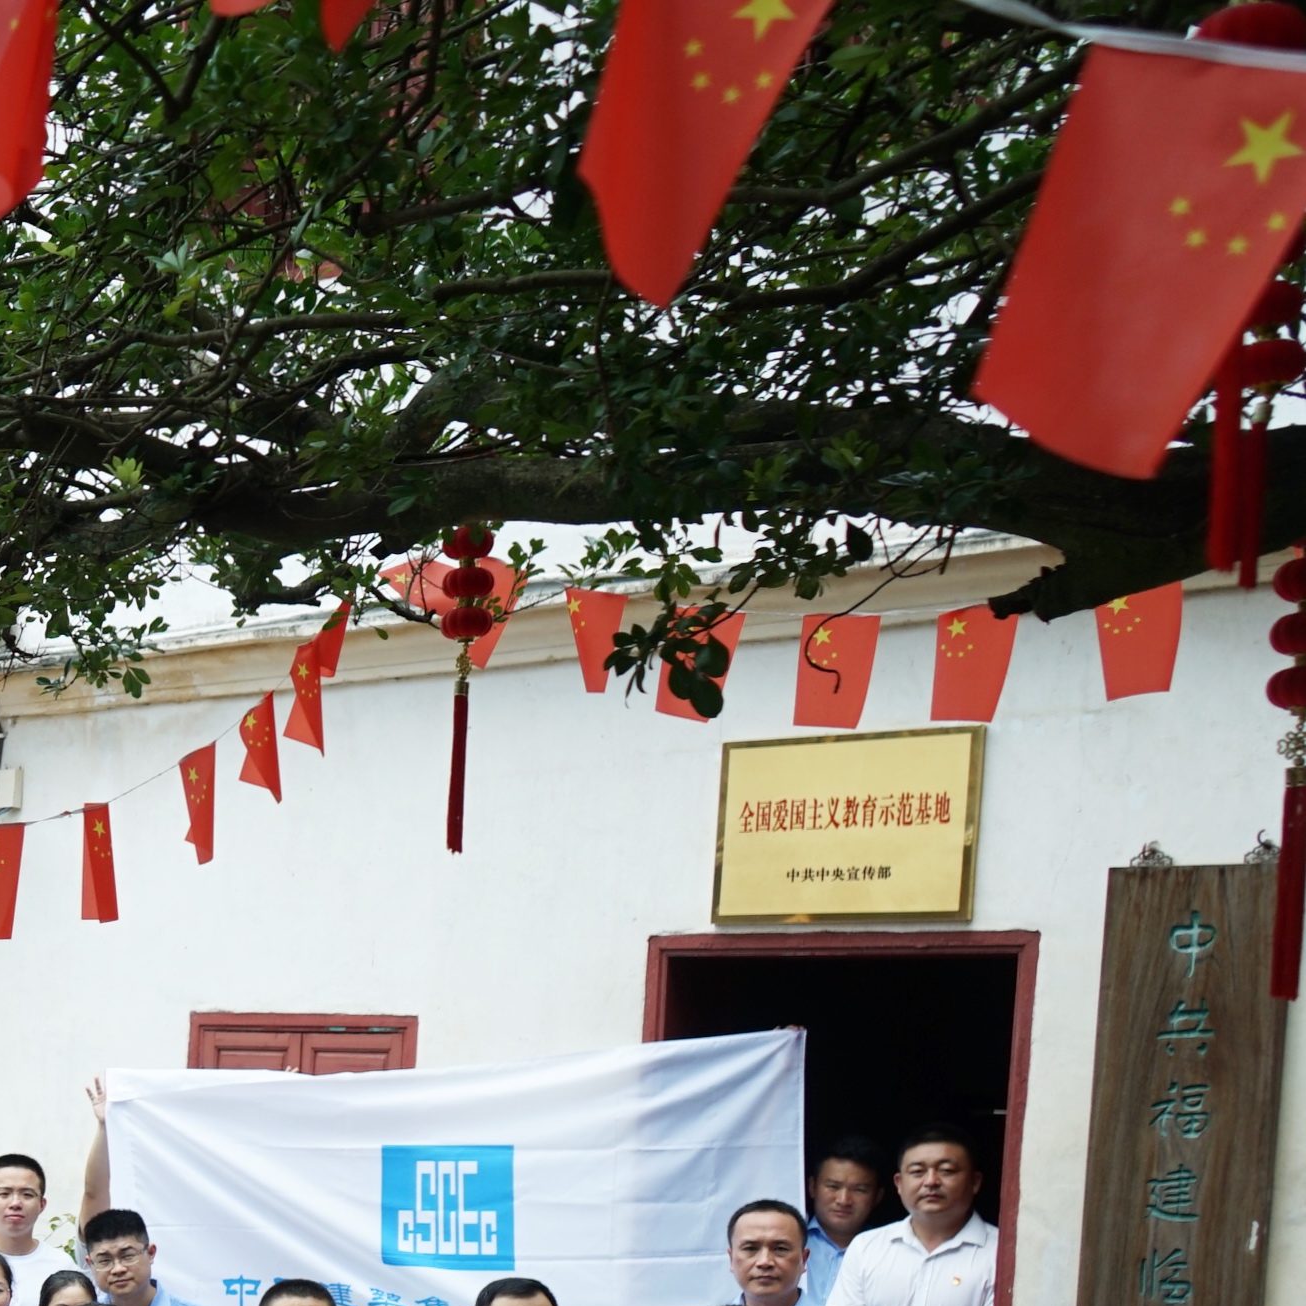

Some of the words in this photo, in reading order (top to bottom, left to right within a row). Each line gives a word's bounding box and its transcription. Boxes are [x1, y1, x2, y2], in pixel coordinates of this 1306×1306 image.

[739, 791, 951, 834] 全国爱国主义教育示范基地
[787, 866, 892, 883] 中共中央宣传部
